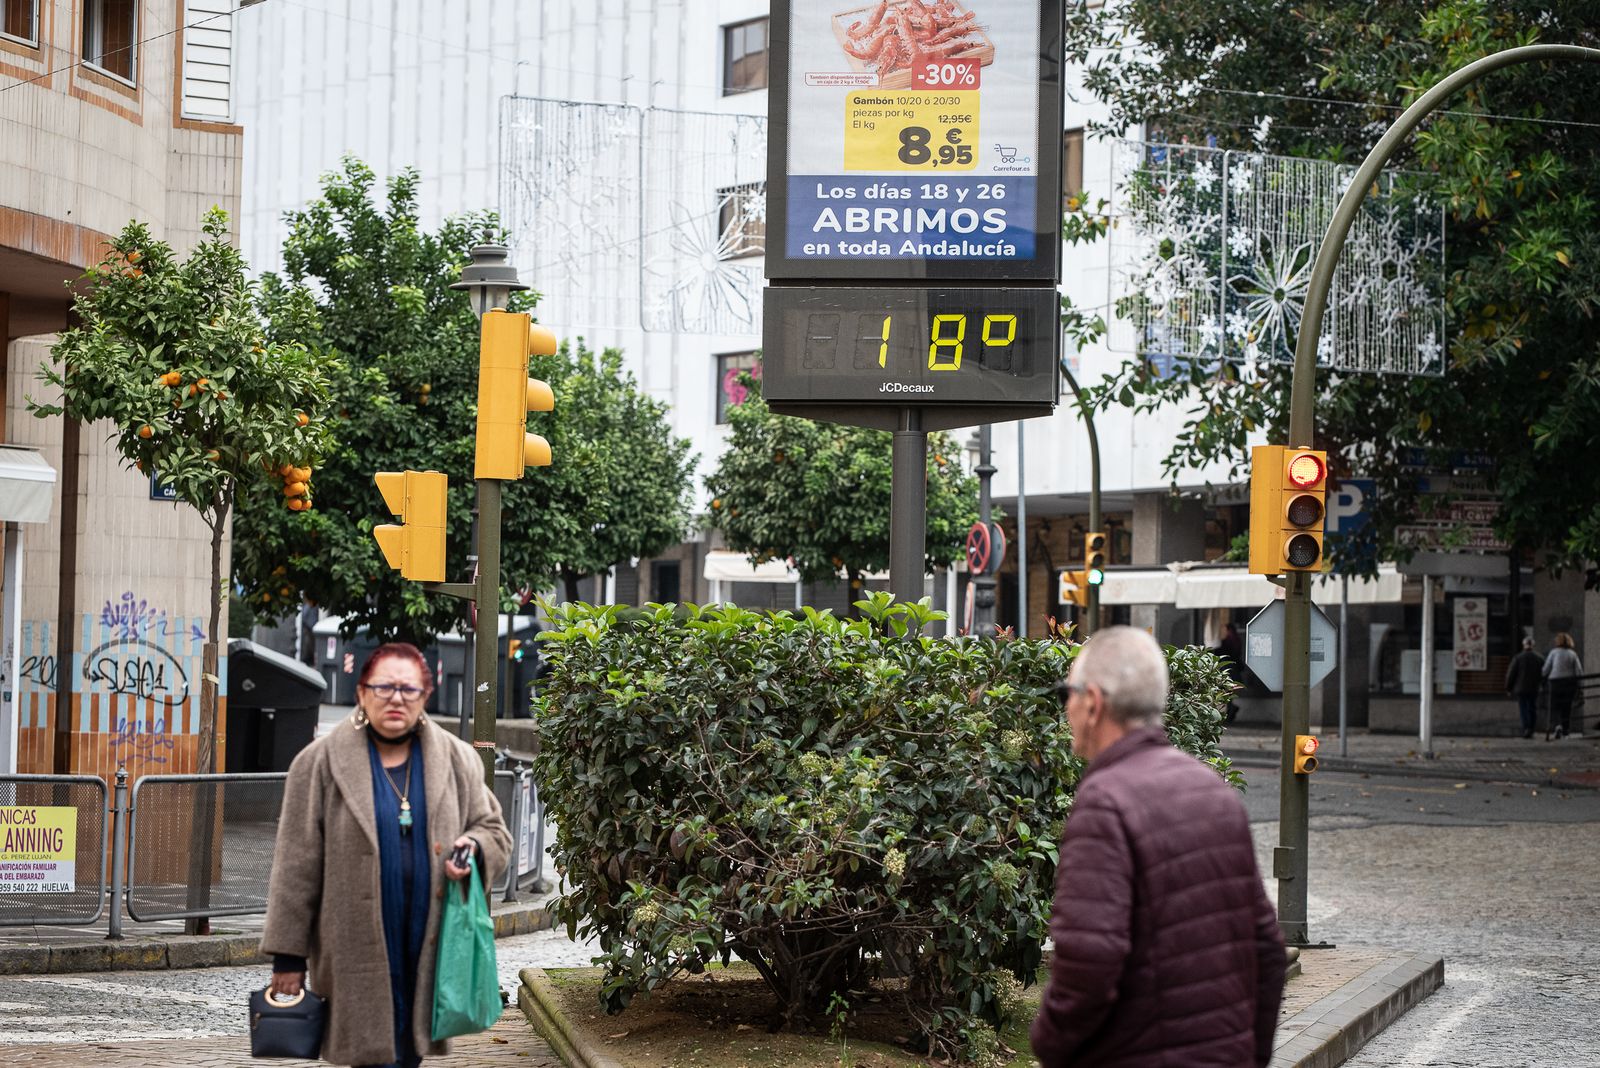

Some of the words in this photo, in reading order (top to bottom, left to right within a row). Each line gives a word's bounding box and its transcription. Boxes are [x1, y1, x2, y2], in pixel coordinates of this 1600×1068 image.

[917, 63, 976, 85] -30%
[853, 96, 894, 106] Gambón
[896, 96, 922, 106] 10/20
[924, 96, 931, 105] ó
[933, 96, 961, 106] 20/30
[853, 109, 883, 118] piezas
[903, 109, 915, 119] kg
[938, 114, 972, 124] 12,95€
[853, 120, 862, 129] El
[864, 121, 876, 131] kg
[945, 128, 963, 145] €
[816, 183, 857, 199] Los
[863, 183, 912, 199] días
[920, 183, 949, 199] 18
[956, 187, 970, 203] y
[976, 183, 1006, 200] 26
[812, 207, 1008, 234] ABRIMOS
[802, 242, 831, 256] en
[837, 240, 891, 256] toda
[898, 239, 1017, 257] Andalucía
[879, 383, 935, 393] JCDecaux
[1327, 484, 1363, 532] P
[0, 827, 63, 853] ANNING
[32, 863, 57, 871] FAMILIAR
[0, 883, 11, 892] 959
[12, 883, 25, 892] 540
[26, 883, 38, 892] 222
[42, 883, 70, 892] HUELVA
